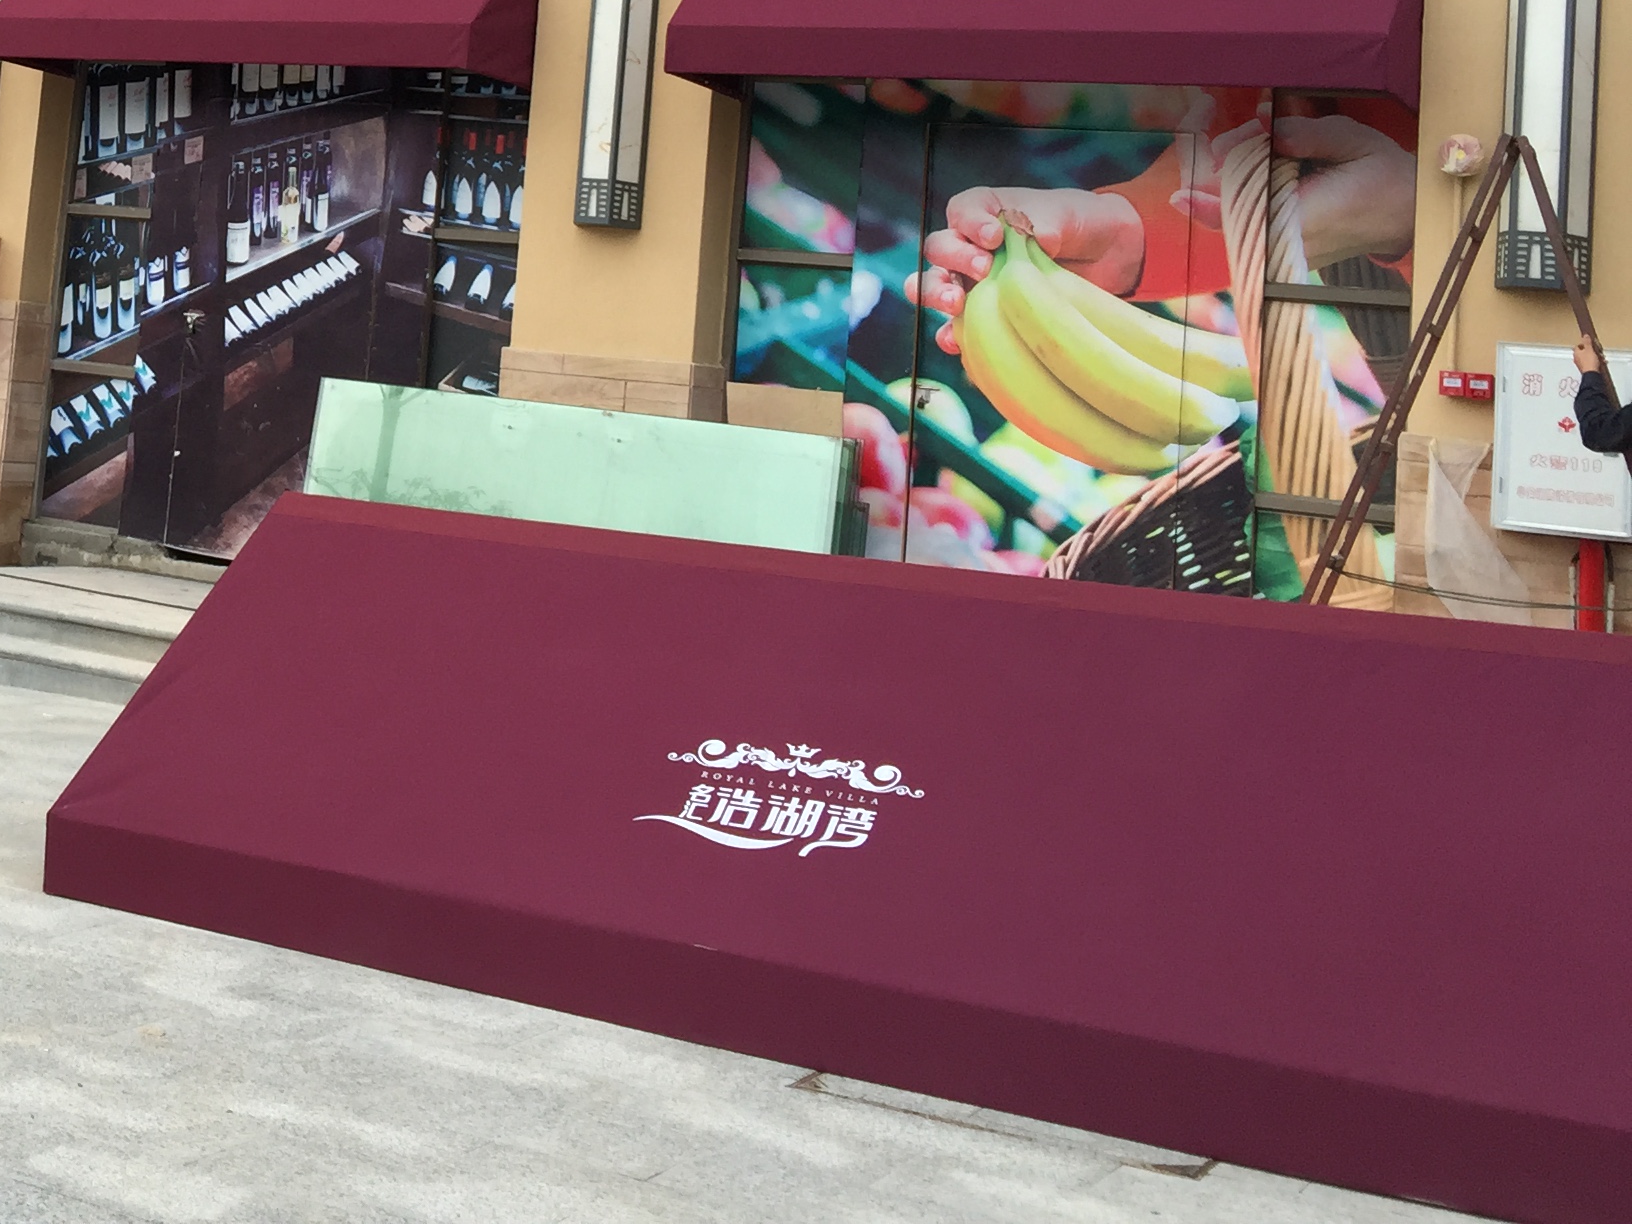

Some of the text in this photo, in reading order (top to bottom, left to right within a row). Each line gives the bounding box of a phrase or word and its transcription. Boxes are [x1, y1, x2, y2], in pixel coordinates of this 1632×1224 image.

[1522, 372, 1580, 398] 消火
[700, 770, 880, 806] ROYAL LAKE VILLA
